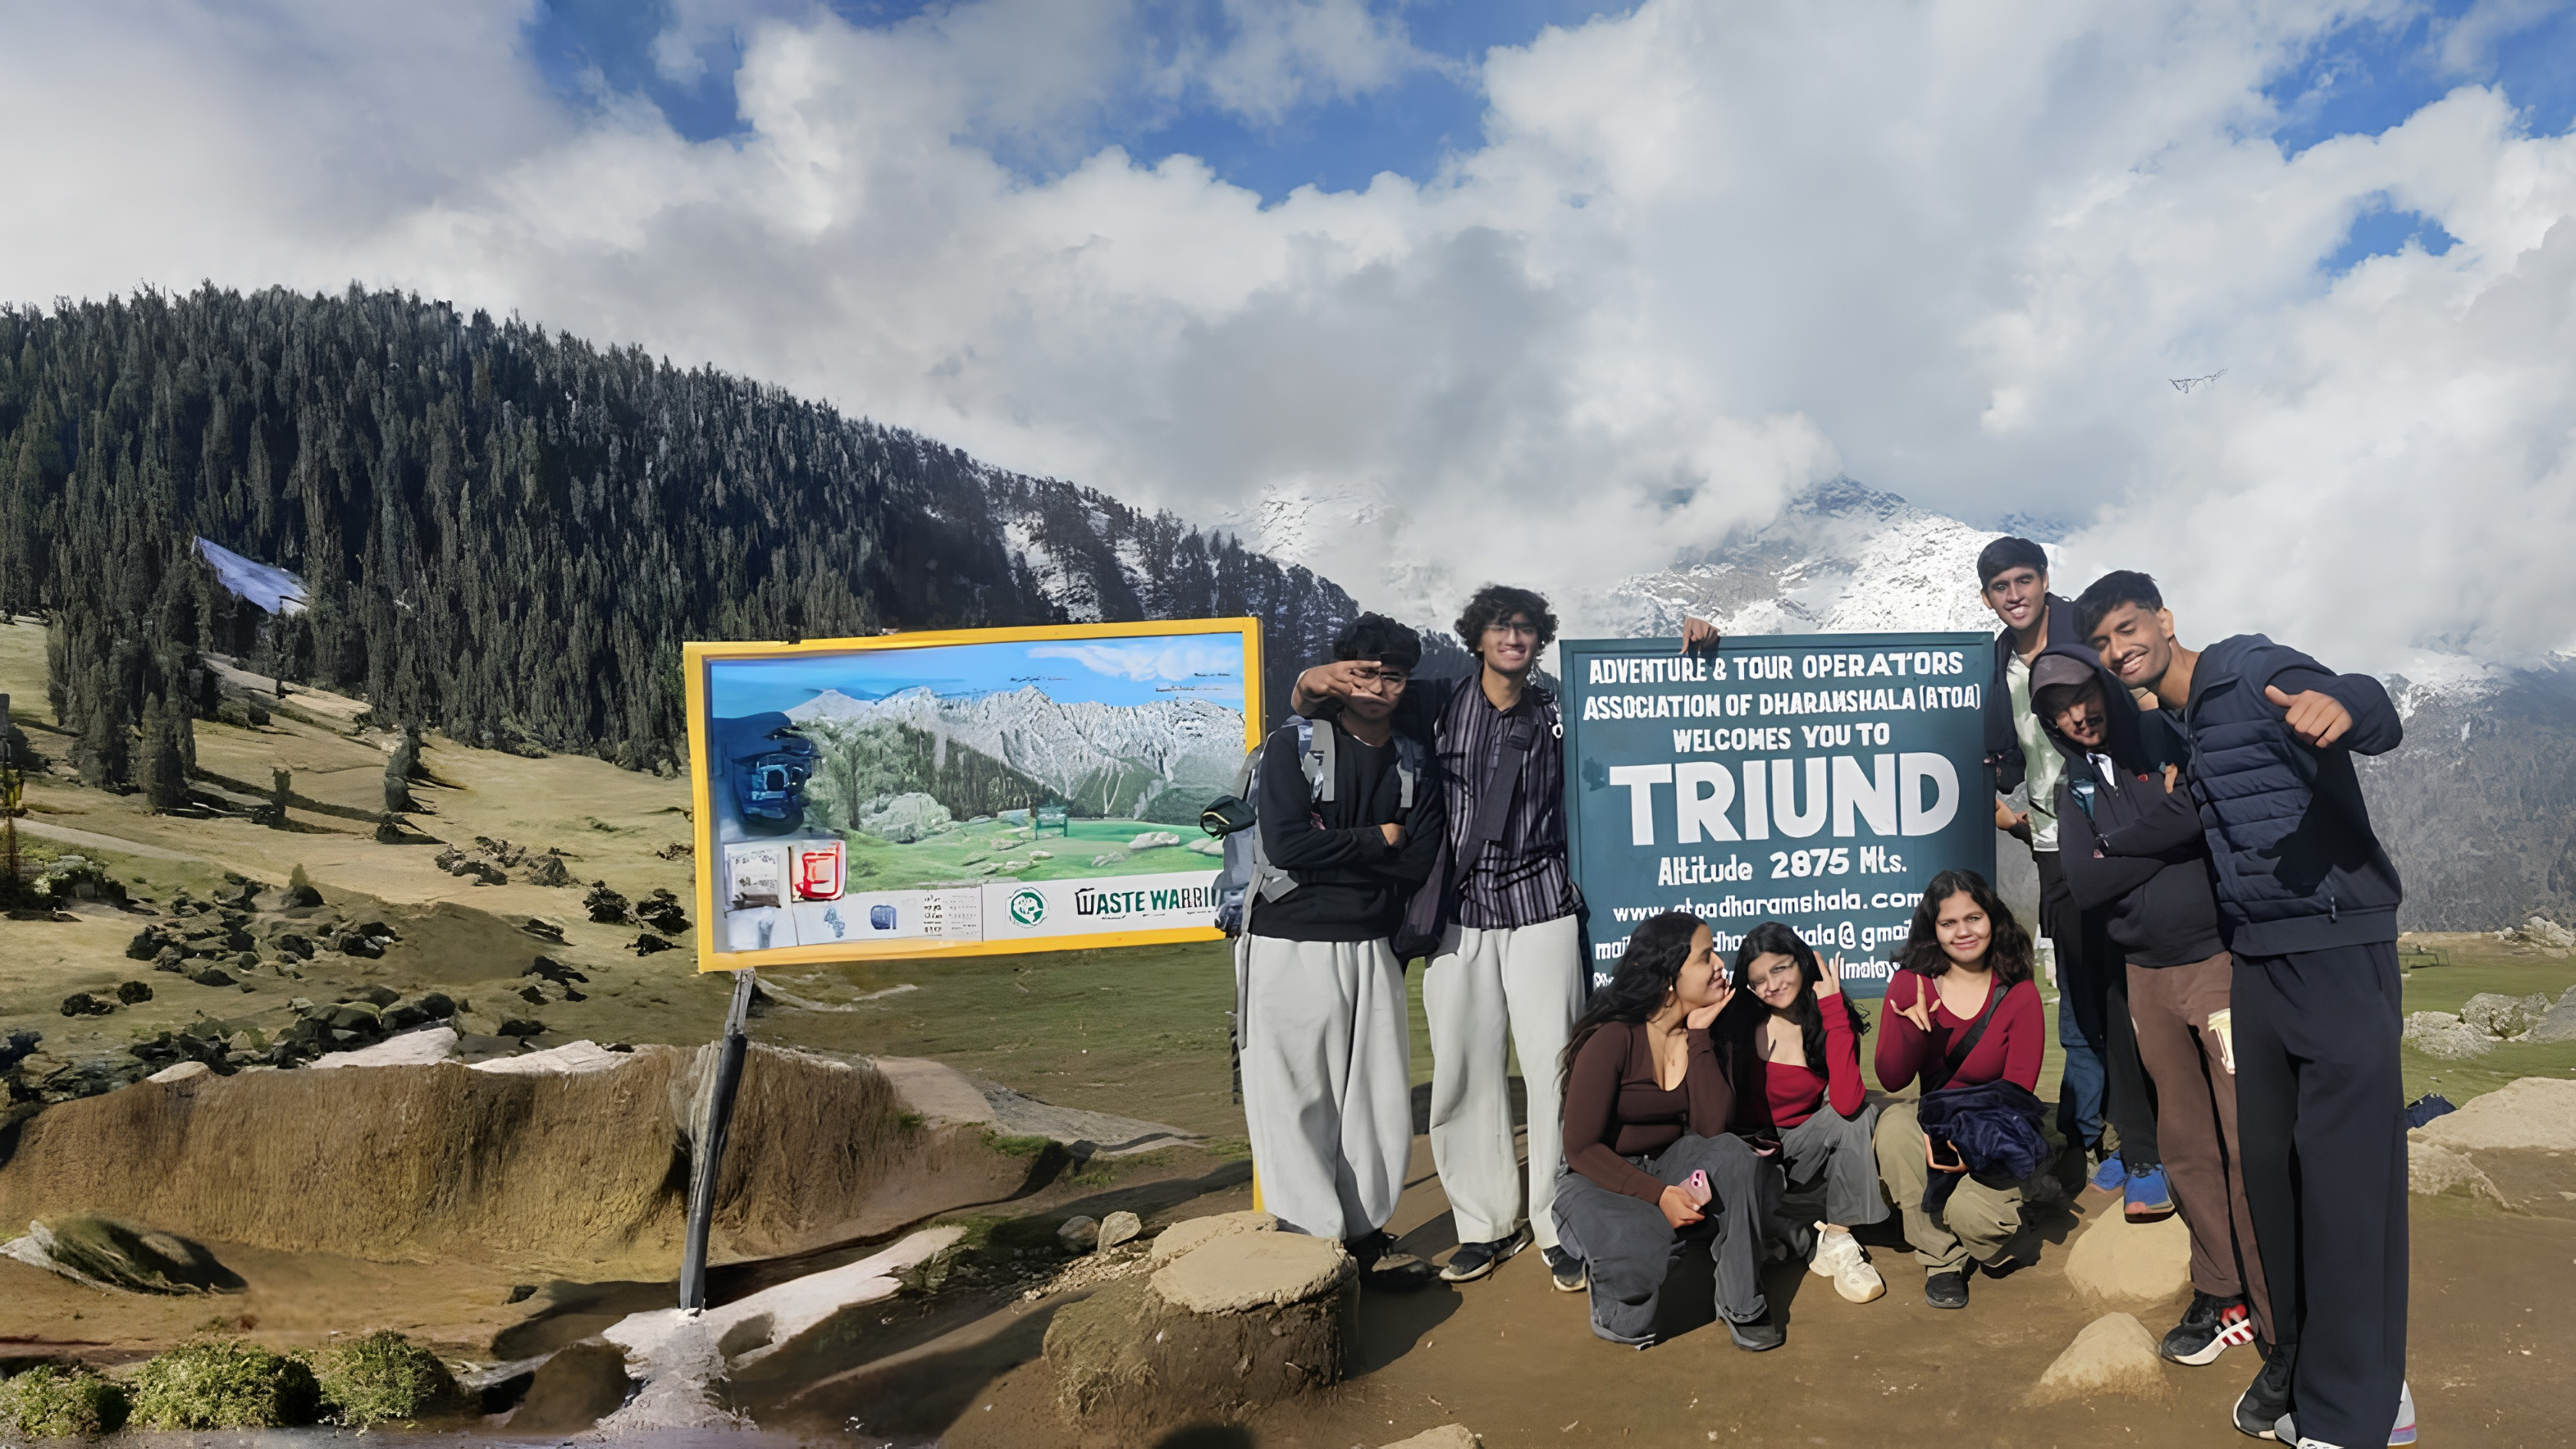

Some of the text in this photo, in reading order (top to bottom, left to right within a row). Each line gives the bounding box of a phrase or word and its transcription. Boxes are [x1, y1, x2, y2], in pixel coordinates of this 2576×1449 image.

[1589, 651, 1963, 685] ADVENTURE & TOUR OPERATORS
[1582, 683, 1980, 721] ASSOCIATION OF DHARAMSHALA (ATOA)
[1672, 722, 1890, 753] WELCOMES YOU TO
[1609, 751, 1960, 846] TRIUND
[1658, 845, 1907, 886] Altitude 2875 Mts.
[1075, 888, 1145, 915] WASTE
[1150, 886, 1216, 911] WARRI
[1612, 887, 1924, 922] wwwatoadharamshala.com
